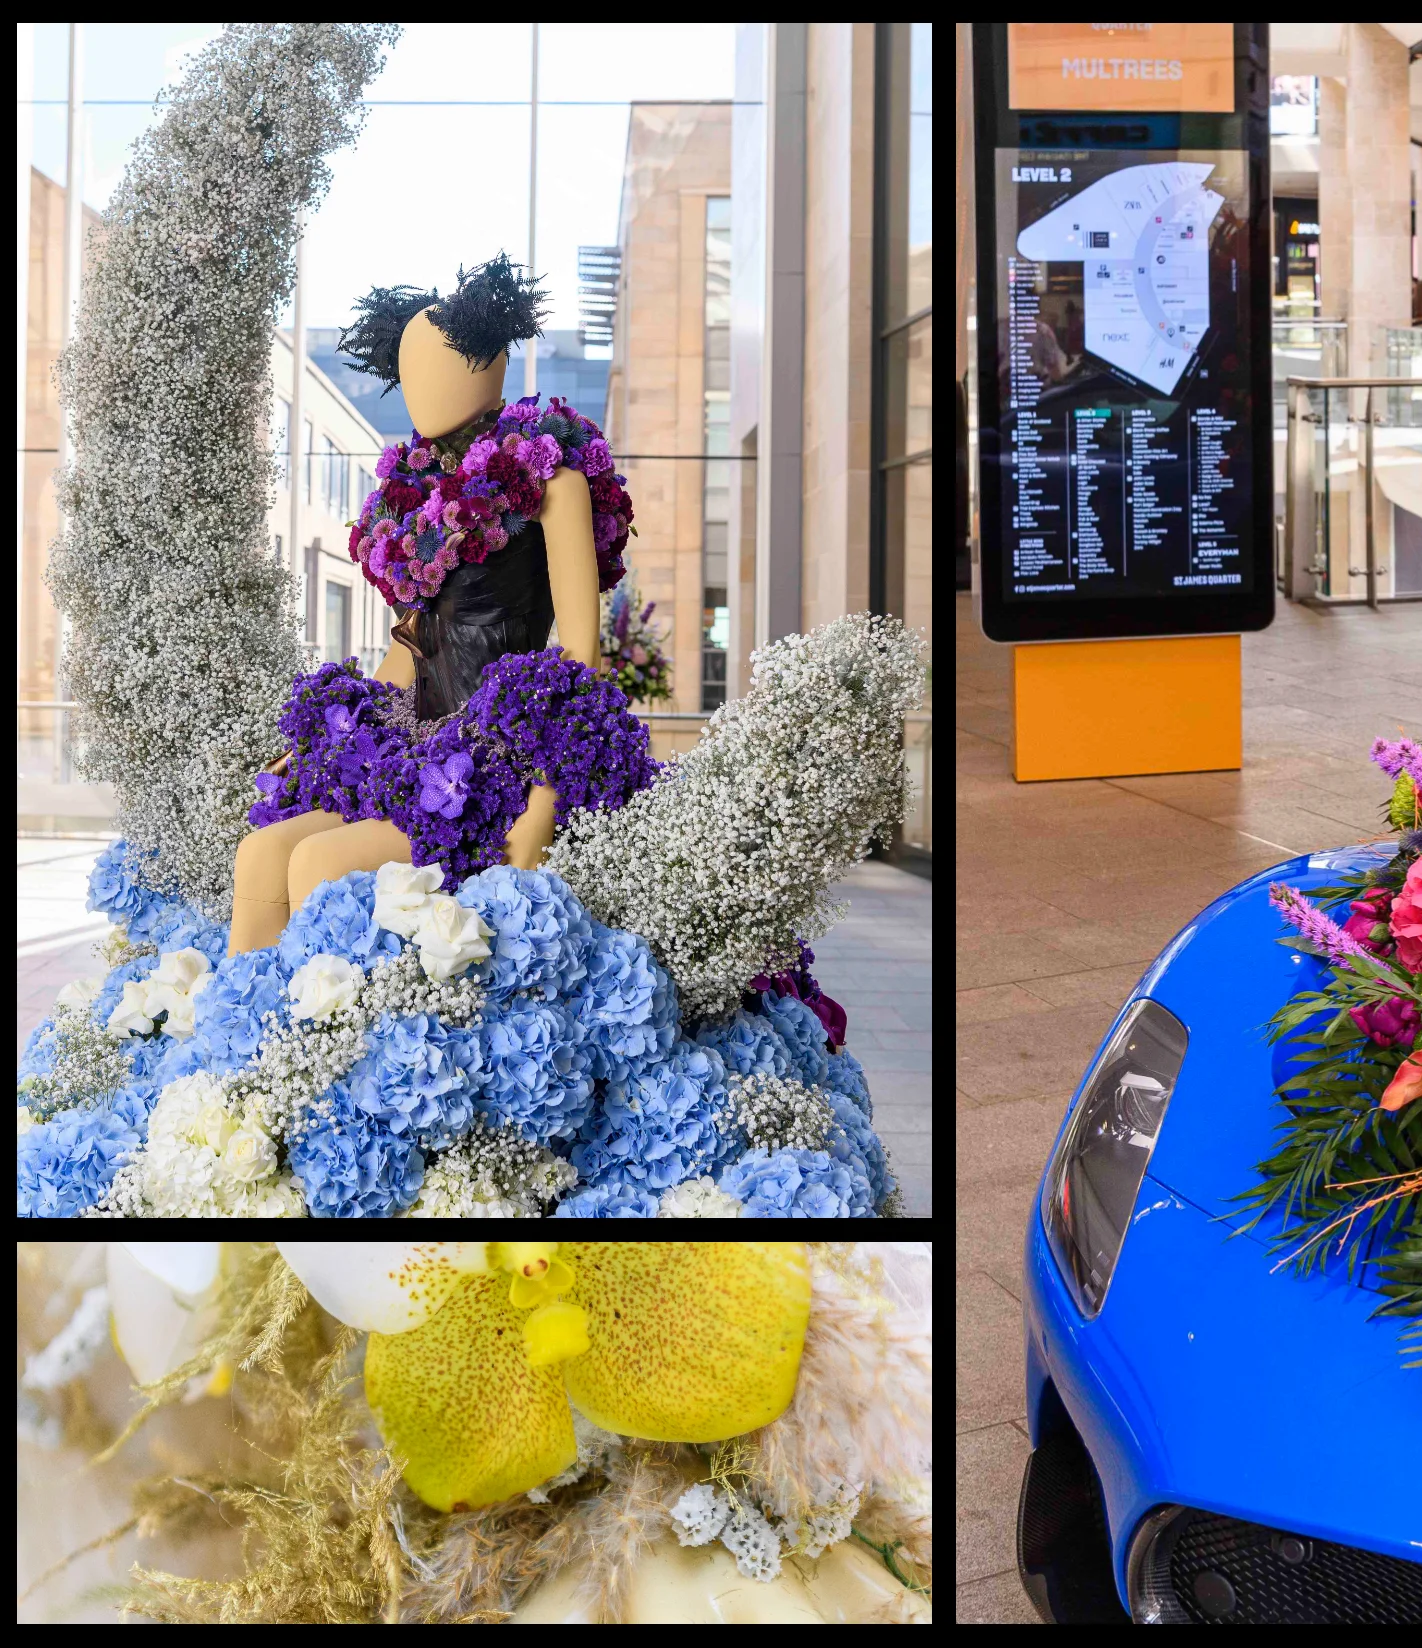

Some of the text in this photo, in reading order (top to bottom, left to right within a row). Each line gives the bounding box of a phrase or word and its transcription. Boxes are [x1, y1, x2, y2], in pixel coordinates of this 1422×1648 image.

[1062, 58, 1182, 80] MULTREES
[1012, 167, 1072, 182] LEVEL 2
[1103, 332, 1130, 342] next
[1198, 548, 1239, 557] EVERYMAN
[1183, 575, 1207, 585] JAMES
[1208, 574, 1242, 585] QUARTER
